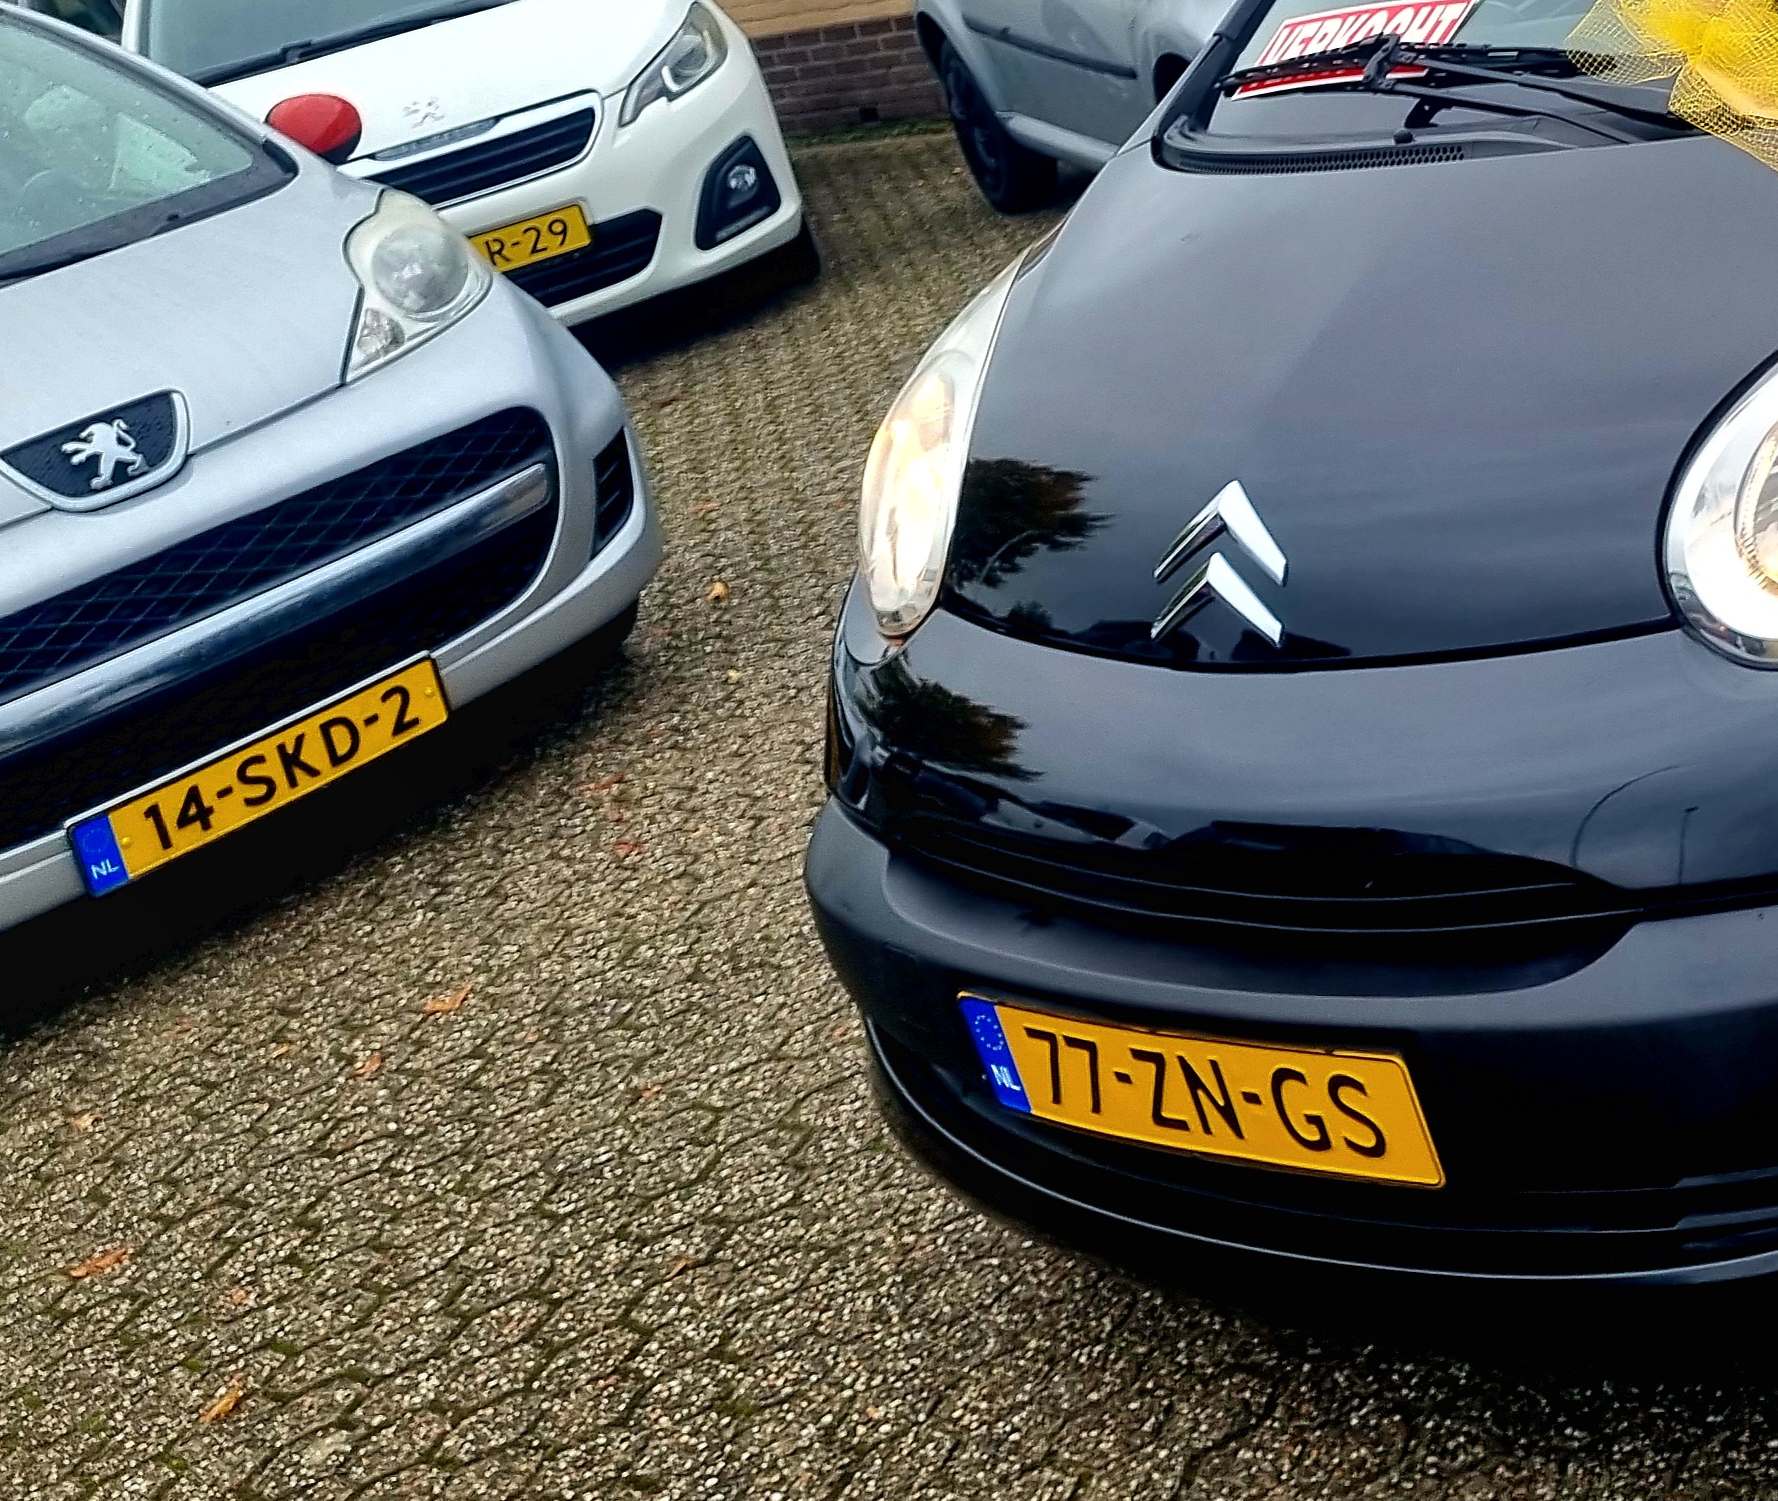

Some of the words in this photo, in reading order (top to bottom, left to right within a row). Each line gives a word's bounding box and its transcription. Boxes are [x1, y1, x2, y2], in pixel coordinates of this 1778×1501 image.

[90, 860, 120, 880] NL
[143, 685, 420, 851] 14-SKD-2
[990, 1062, 1021, 1092] NL
[1024, 1025, 1387, 1158] 77-ZN-GS
